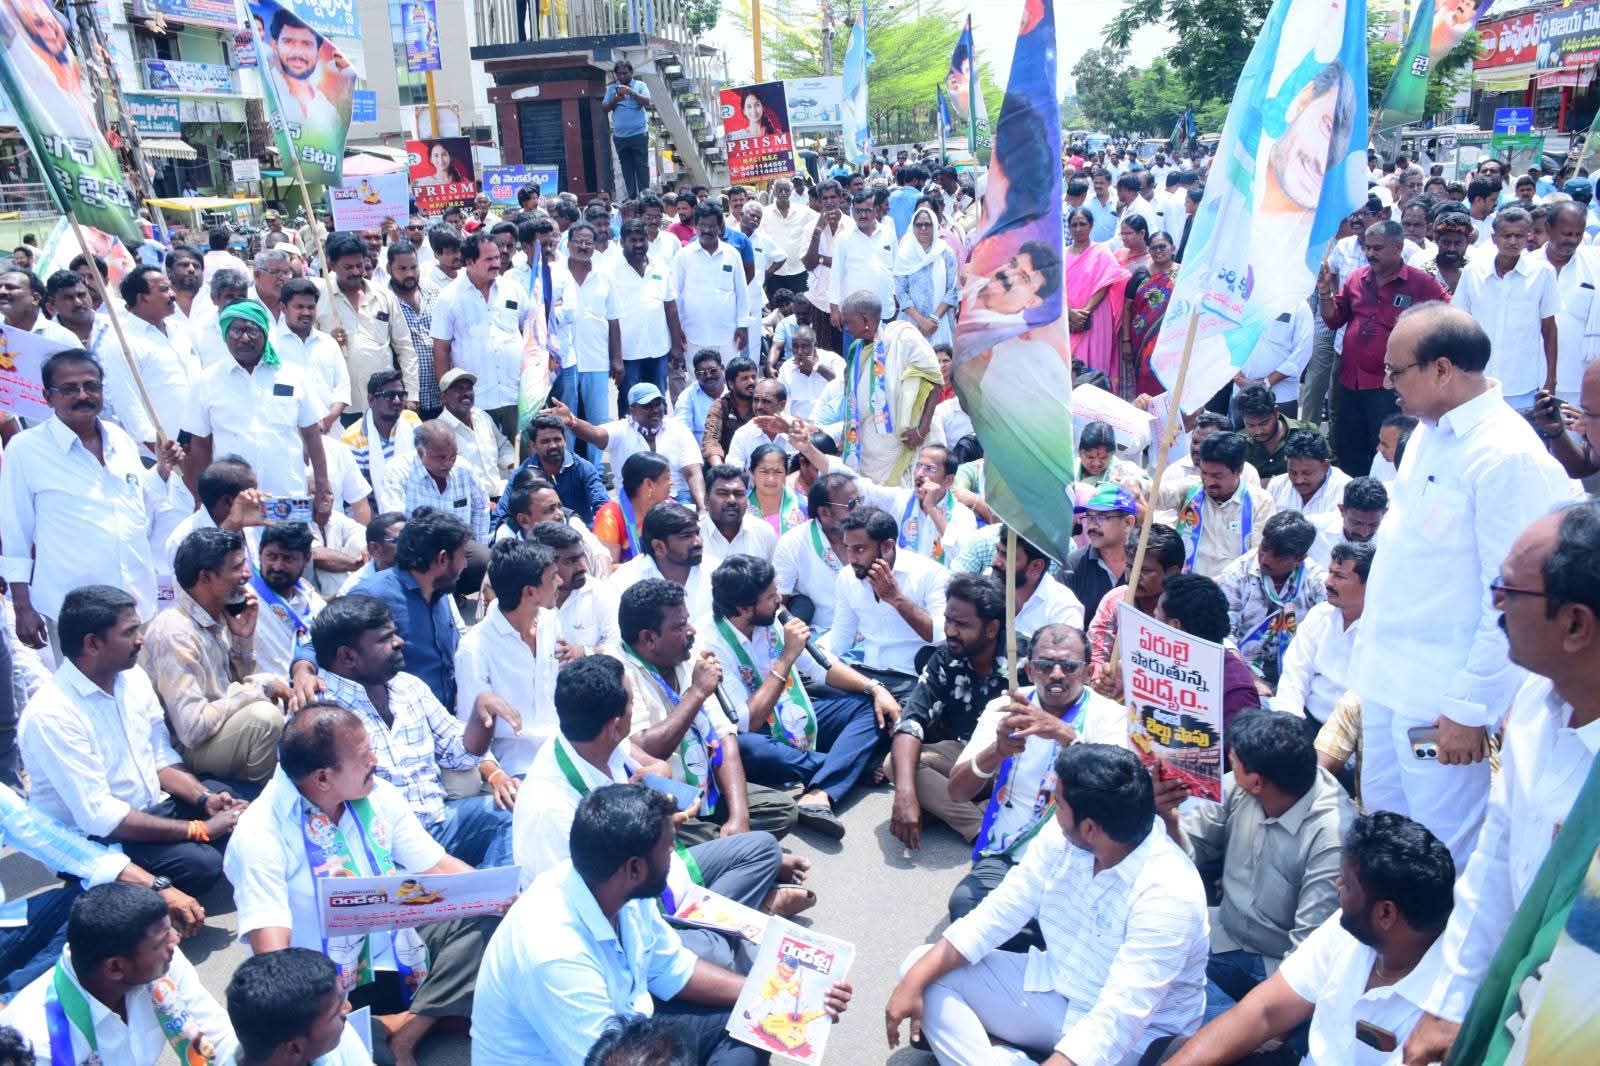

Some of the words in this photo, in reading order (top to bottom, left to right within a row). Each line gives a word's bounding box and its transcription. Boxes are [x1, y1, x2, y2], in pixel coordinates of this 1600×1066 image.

[727, 134, 787, 153] PRISM
[413, 182, 474, 198] PRISM
[1139, 625, 1190, 667] ఏరులై
[1131, 650, 1209, 692] పారుతున్న
